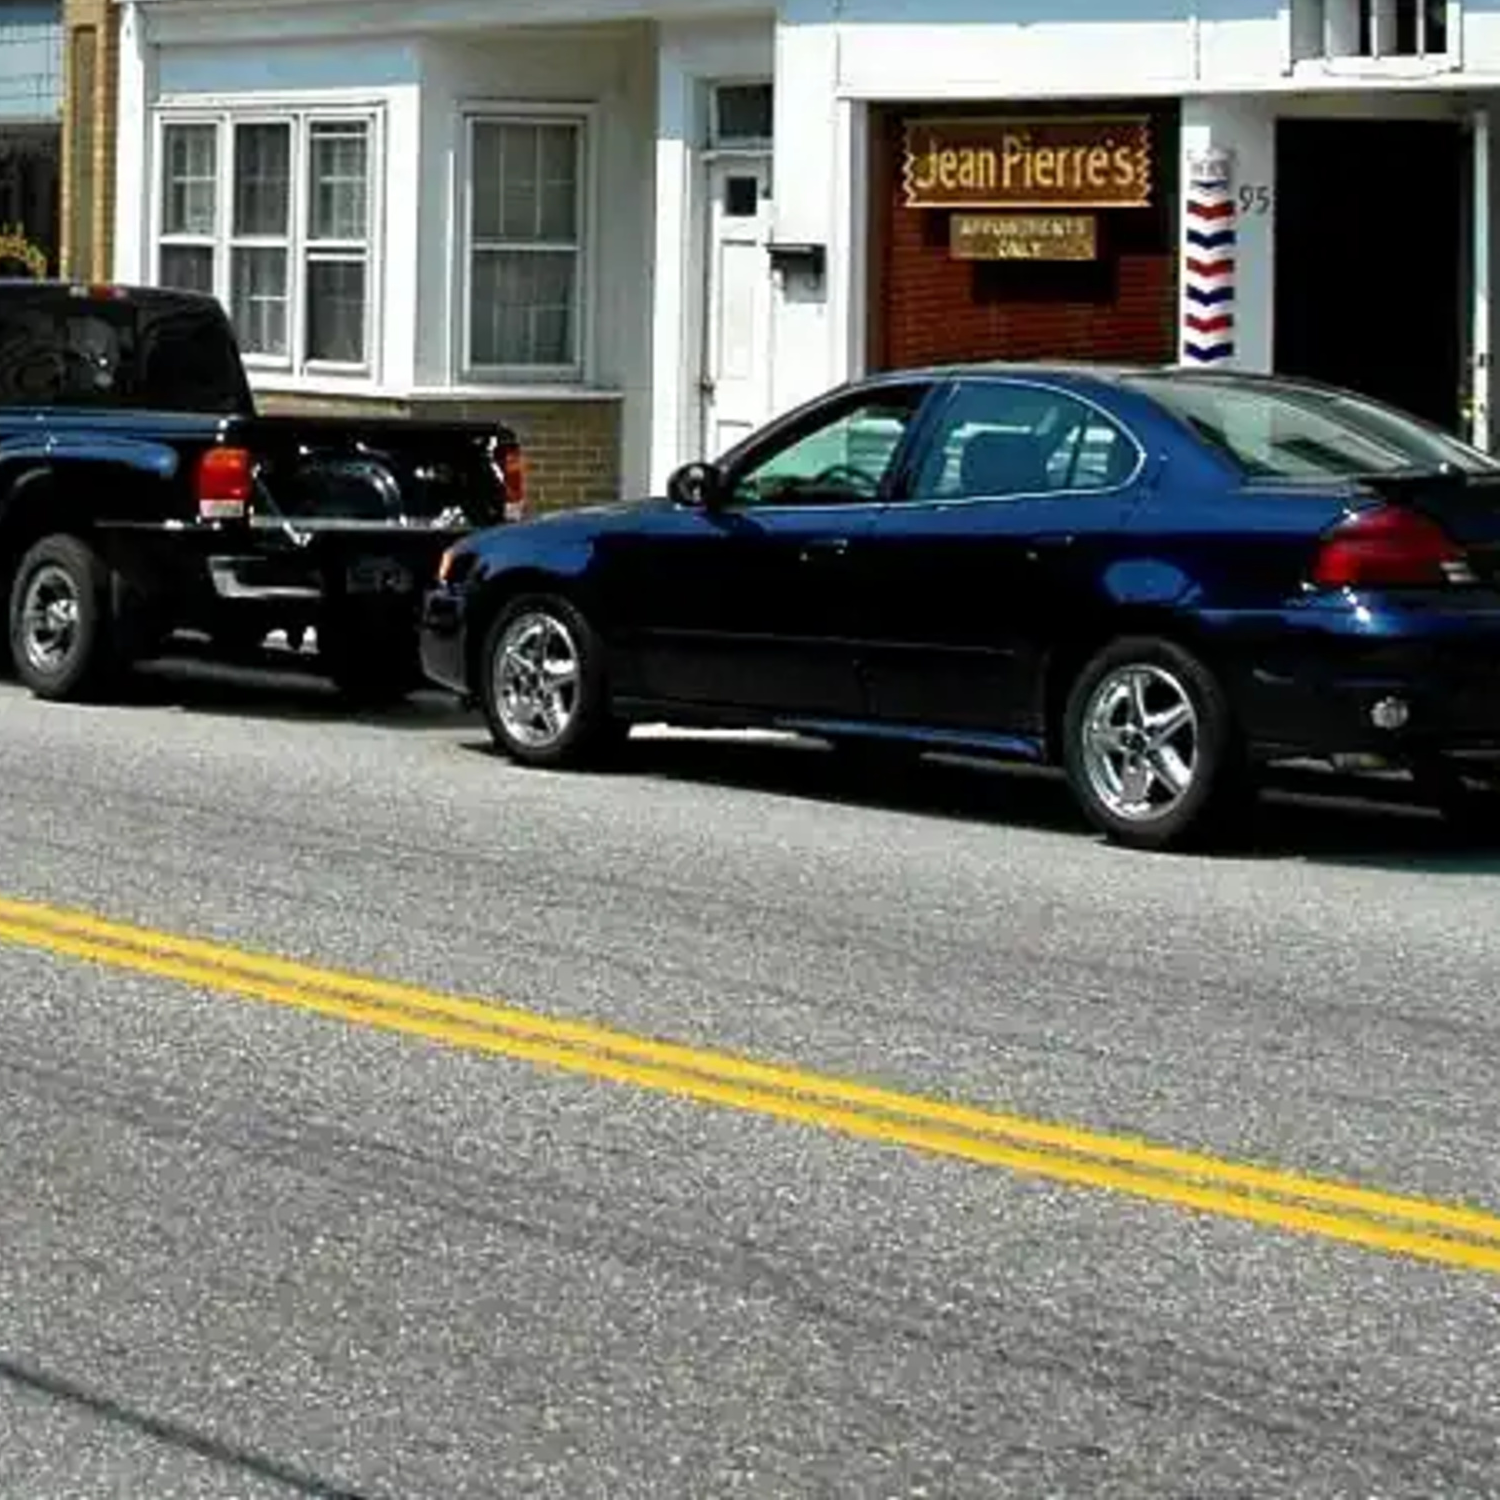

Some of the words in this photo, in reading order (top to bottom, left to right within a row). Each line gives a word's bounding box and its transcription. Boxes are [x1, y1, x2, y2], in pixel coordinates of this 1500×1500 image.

[915, 139, 996, 189] Jean
[1002, 133, 1135, 188] Pierre's
[1239, 184, 1271, 216] 95
